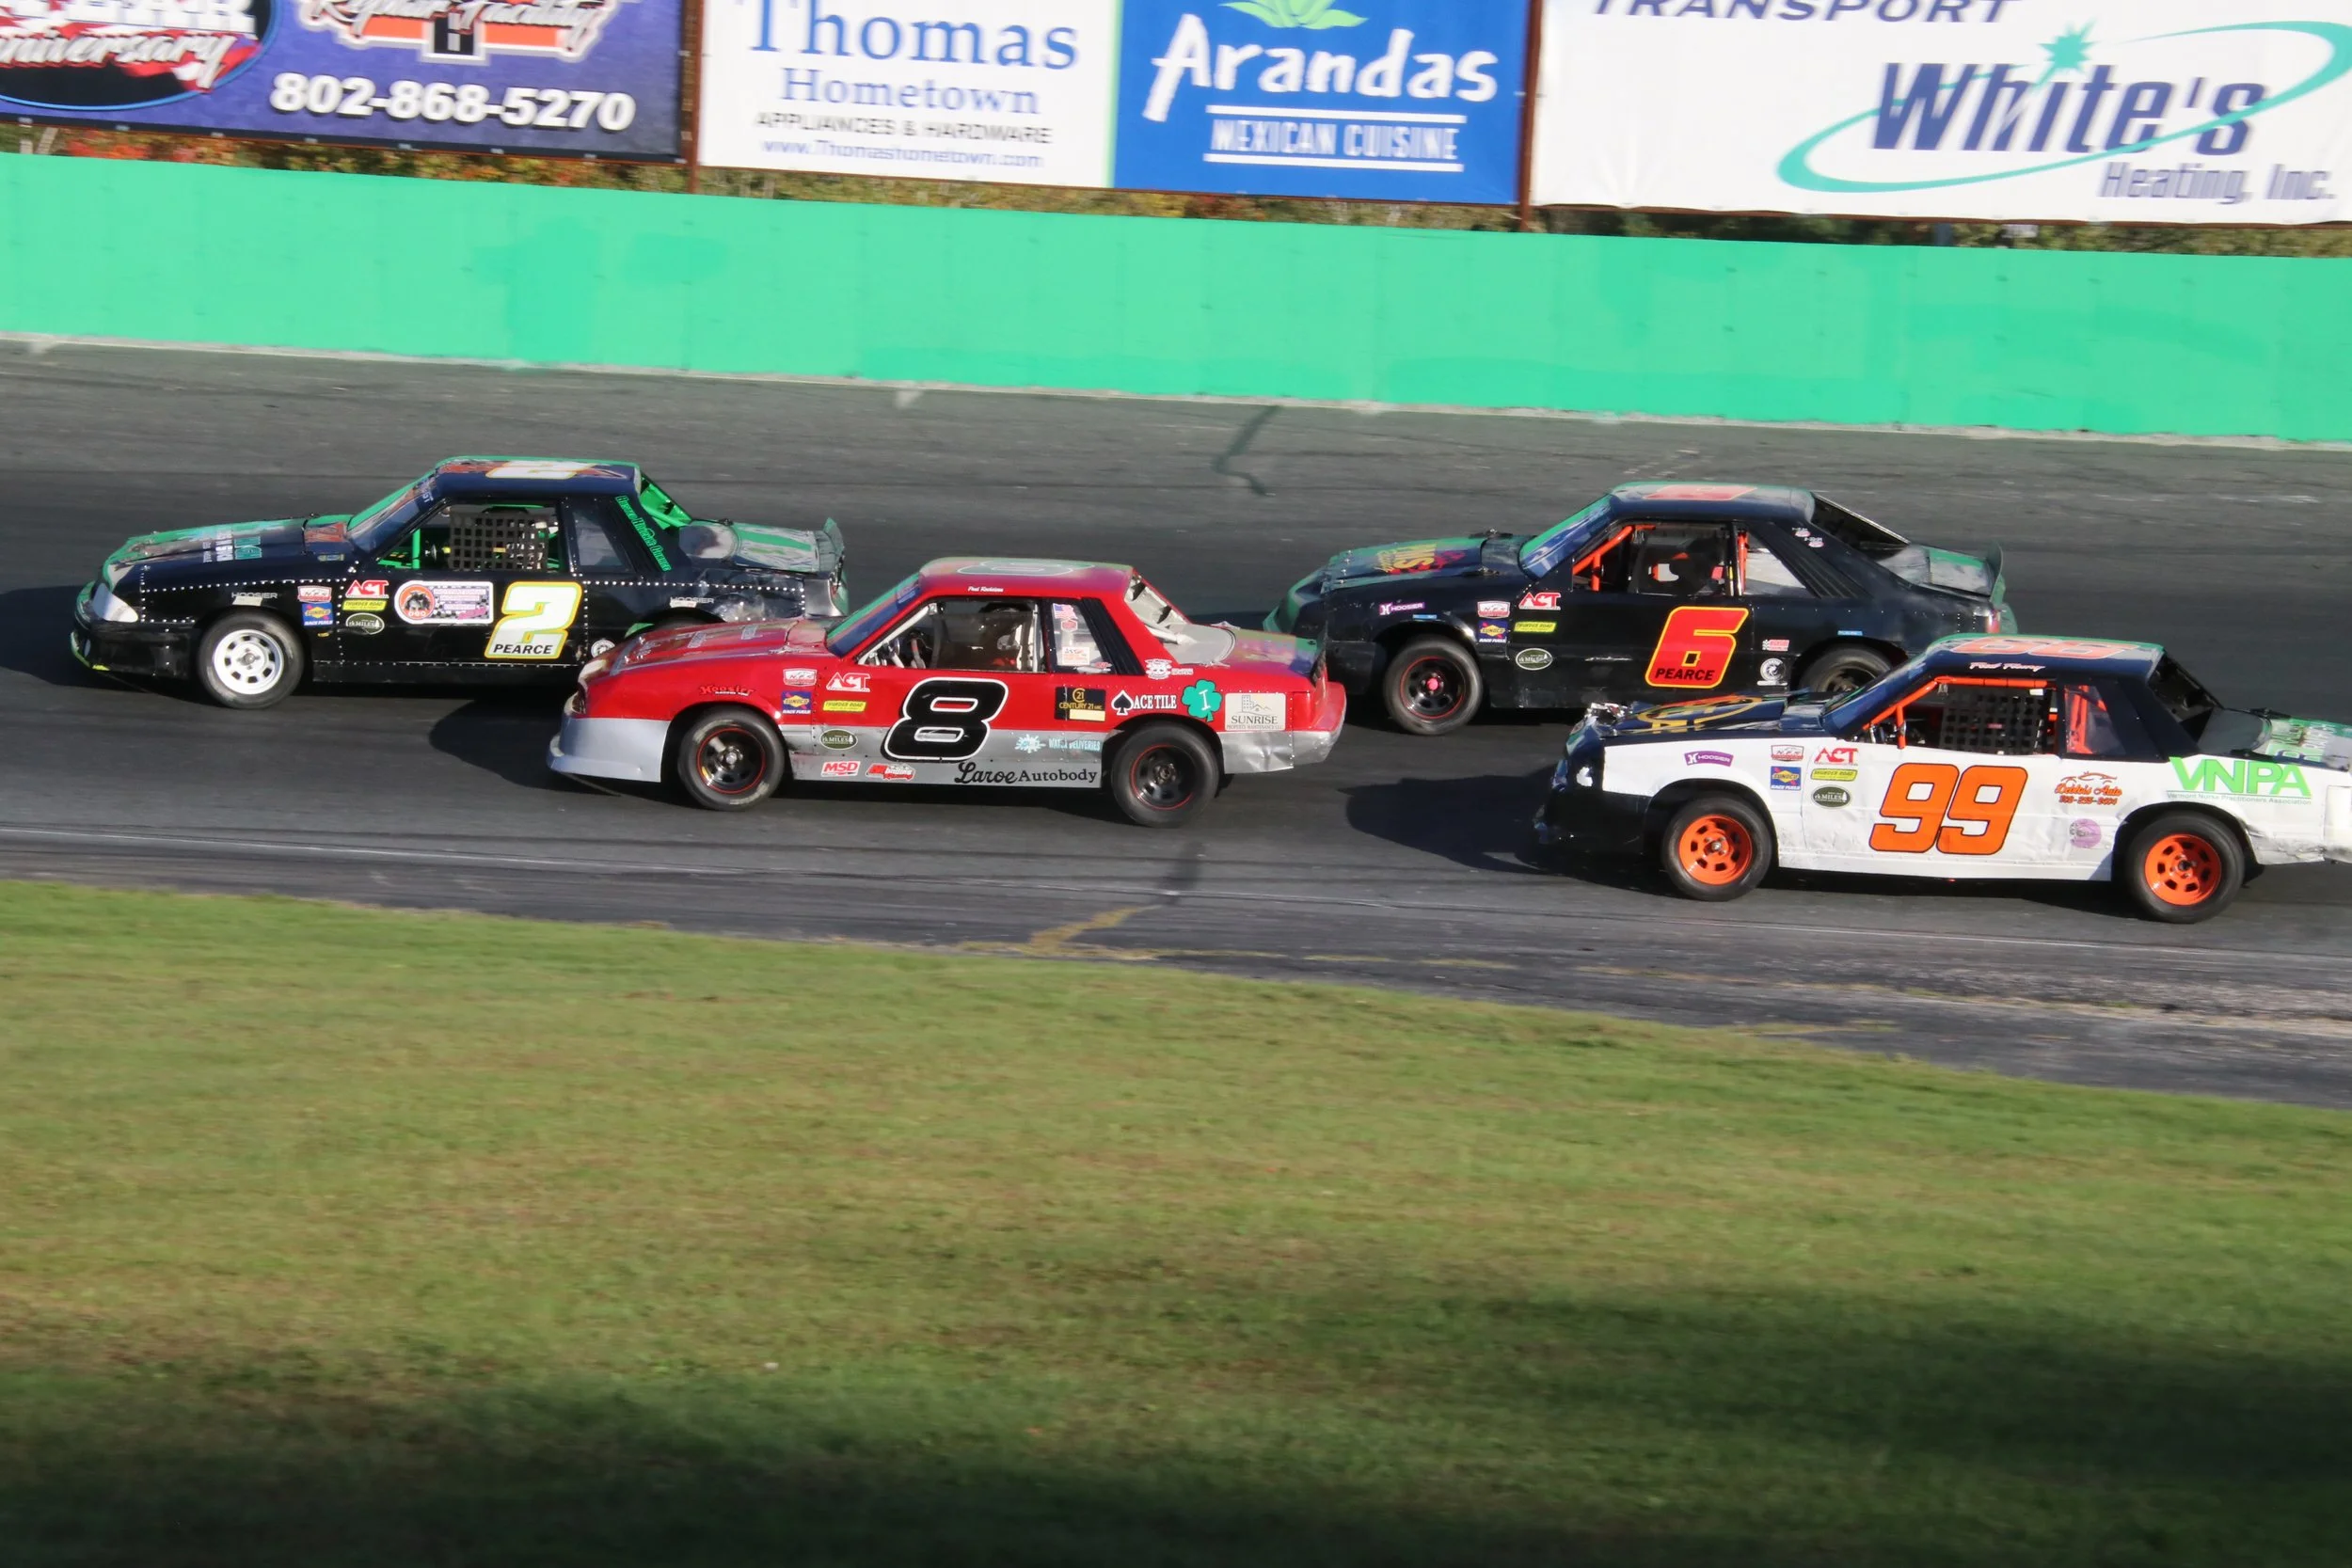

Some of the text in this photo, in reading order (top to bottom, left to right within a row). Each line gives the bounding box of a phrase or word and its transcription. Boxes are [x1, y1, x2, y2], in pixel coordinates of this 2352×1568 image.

[750, 0, 1079, 70] Thomas
[1141, 13, 1499, 122] Arandas
[271, 72, 637, 132] 802-868-5270
[780, 67, 1041, 114] Hometown
[1871, 62, 2269, 156] White's
[756, 111, 1054, 144] APPLIANCES & HARDWARE
[1210, 119, 1459, 160] MEXICAN CUISINE
[2096, 161, 2339, 205] Heating, Inc.
[1391, 603, 1424, 611] HOOSIER
[1518, 593, 1562, 610] ACT
[485, 581, 582, 658] 2
[493, 643, 553, 655] PEARCE
[1645, 606, 1749, 689] 6
[1655, 668, 1715, 681] PEARCE
[699, 685, 754, 696] Hoosier
[1133, 694, 1177, 709] ACE TILE
[881, 677, 1009, 763] 8
[1058, 702, 1088, 710] CENTURY
[1231, 715, 1279, 724] SUNRISE
[823, 762, 858, 772] MSD
[1697, 753, 1732, 763] HOOSIER
[1813, 748, 1860, 767] ACT
[954, 761, 1099, 784] Laroe Autobody
[2169, 756, 2312, 797] VNPA
[1868, 762, 2029, 856] 99
[2220, 794, 2267, 803] Practitioners
[2268, 797, 2312, 806] Association
